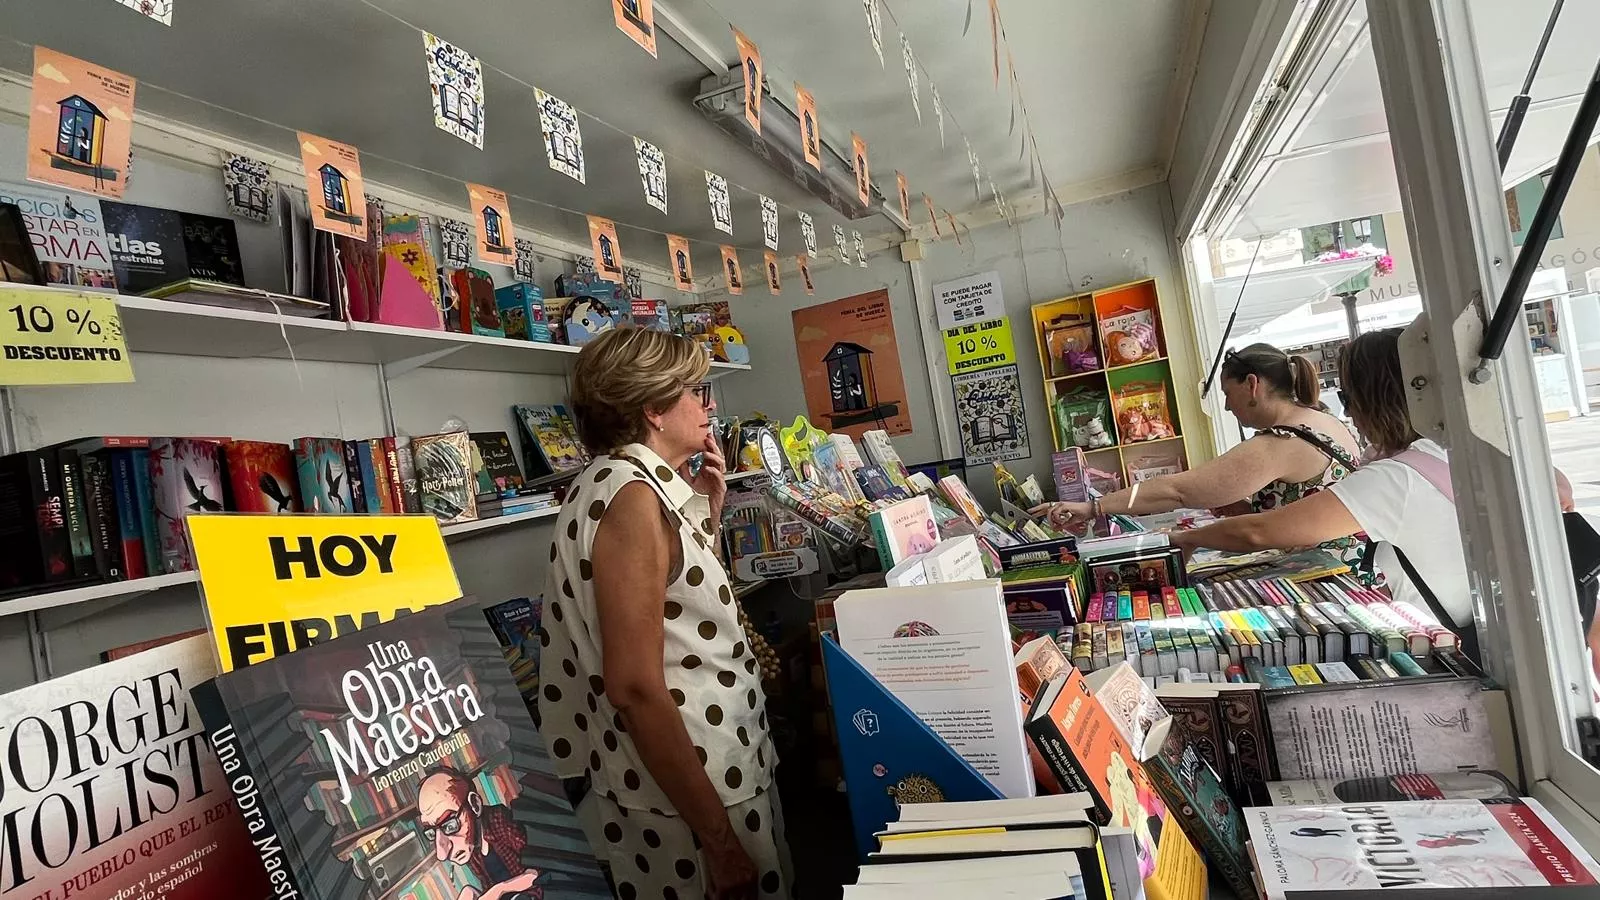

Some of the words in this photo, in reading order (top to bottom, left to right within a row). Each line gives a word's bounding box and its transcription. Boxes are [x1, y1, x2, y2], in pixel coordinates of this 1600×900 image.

[83, 226, 100, 237] EN
[110, 233, 163, 257] tlas
[32, 233, 108, 263] RMA
[125, 256, 165, 265] estrellas
[951, 288, 970, 296] PUEDE
[971, 282, 992, 291] PAGAR
[958, 292, 983, 303] TARJETA
[1370, 281, 1417, 302] MUS
[8, 304, 54, 332] 10
[66, 308, 101, 335] %
[963, 325, 977, 335] DEL
[980, 319, 1003, 331] LIBRO
[3, 345, 121, 361] DESCUENTO
[957, 338, 976, 355] 10
[981, 335, 997, 350] %
[955, 353, 1006, 369] DESCUENTO
[63, 464, 70, 474] MI
[64, 476, 76, 508] QUERIDA
[422, 479, 442, 493] Harry
[442, 477, 464, 490] Potter
[267, 534, 398, 581] HOY
[367, 638, 413, 667] Una
[341, 656, 446, 724] Obra
[0, 668, 190, 800] ORGE
[320, 683, 485, 805] Maestra
[372, 763, 419, 793] Lorenzo
[418, 732, 472, 766] Caudevilla
[1059, 753, 1072, 768] vivir
[211, 723, 241, 775] Una
[231, 774, 266, 834] Obra
[252, 833, 299, 900] Maest
[62, 848, 136, 895] PUEBLO
[139, 827, 175, 858] QUE
[179, 817, 202, 839] EL
[204, 799, 235, 827] REY
[1341, 805, 1427, 888] VICTORIA
[138, 879, 146, 894] y
[148, 870, 167, 885] las
[169, 842, 218, 873] sombras
[157, 861, 204, 893] español
[1273, 860, 1289, 884] PALOMA
[1547, 854, 1576, 883] PREMIO
